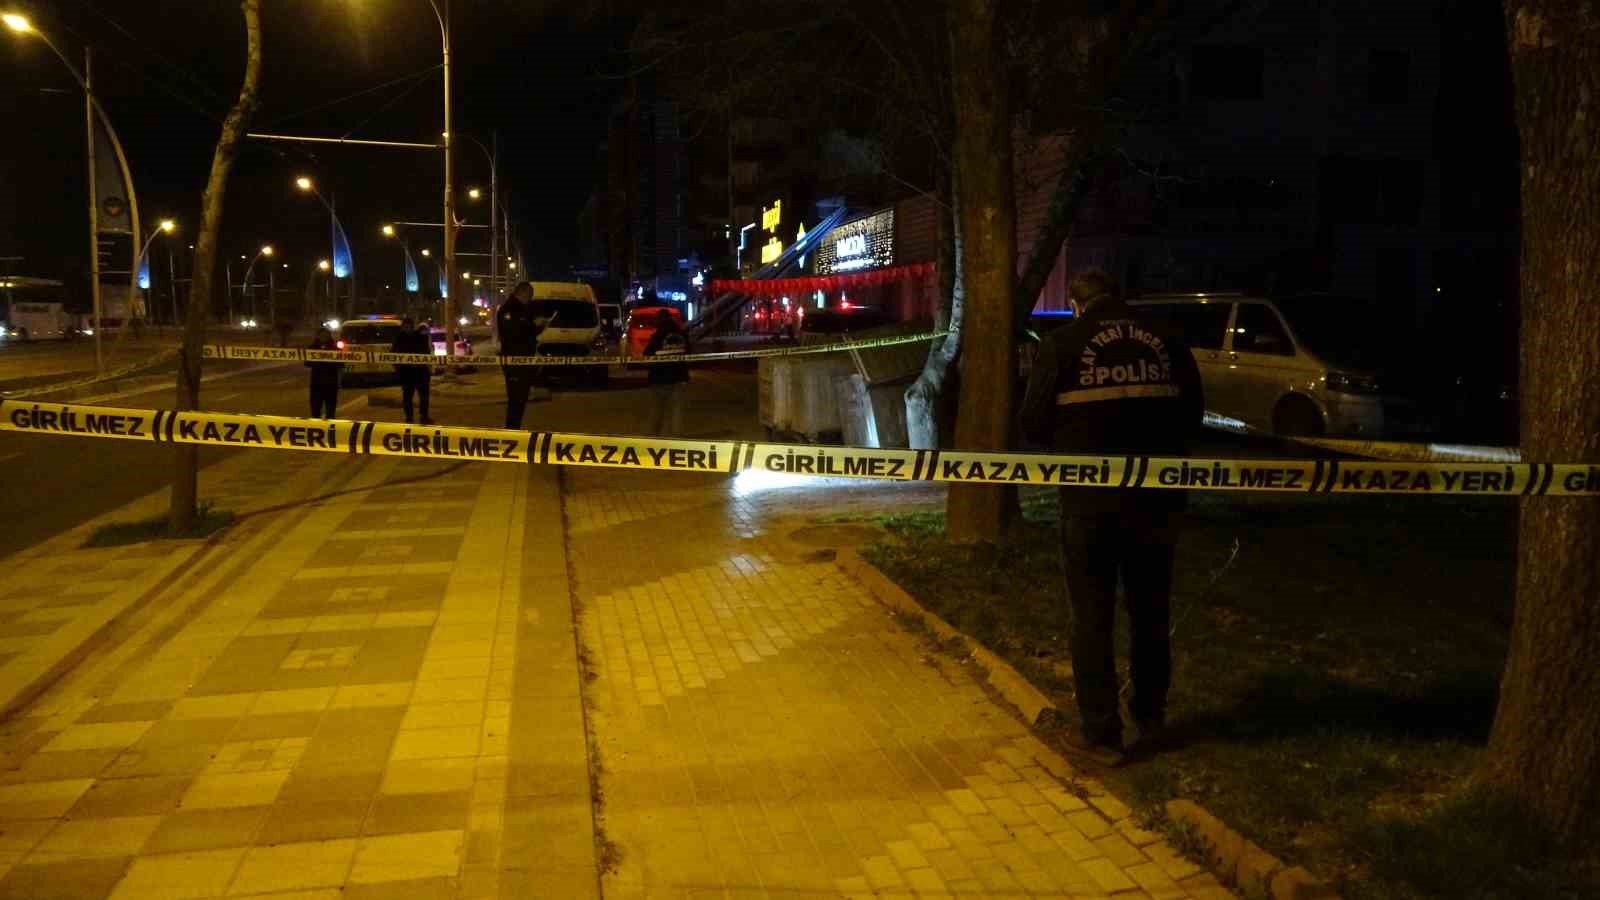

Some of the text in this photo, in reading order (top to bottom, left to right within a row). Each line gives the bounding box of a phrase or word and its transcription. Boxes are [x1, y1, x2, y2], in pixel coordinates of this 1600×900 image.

[1096, 359, 1161, 384] POLİS
[10, 404, 145, 437] GİRİLMEZ
[179, 419, 262, 444] KAZA
[268, 422, 337, 449] YERİ
[383, 429, 520, 459] GİRİLMEZ
[555, 443, 639, 466] KAZA
[646, 445, 717, 469] YERİ
[765, 448, 905, 478] GİRİLMEZ
[943, 460, 1028, 482] KAZA
[1040, 459, 1110, 484] YERİ
[1158, 461, 1304, 489] GİRİLMEZ
[1343, 469, 1431, 491] KAZA
[1440, 465, 1514, 492] YERİ
